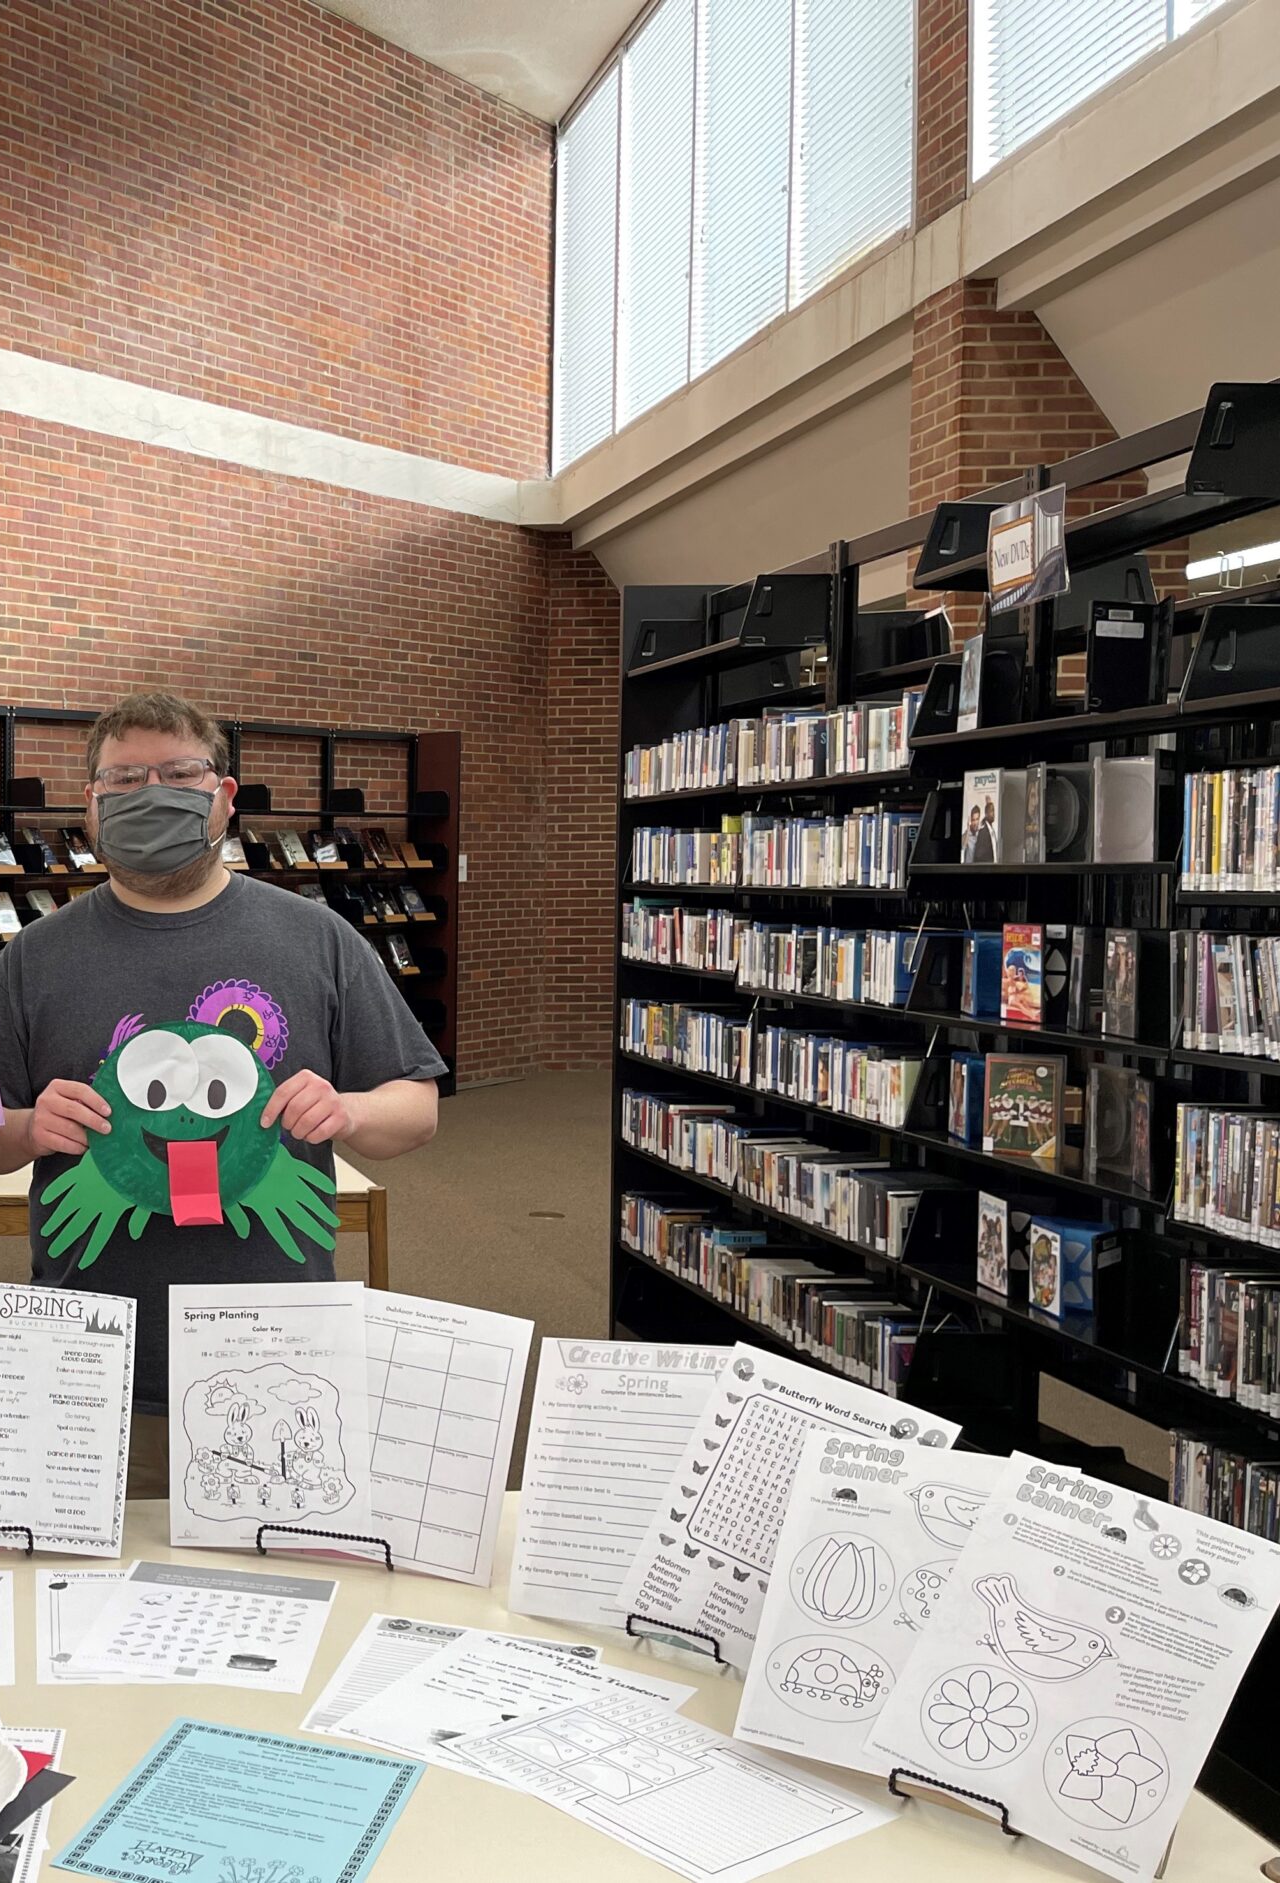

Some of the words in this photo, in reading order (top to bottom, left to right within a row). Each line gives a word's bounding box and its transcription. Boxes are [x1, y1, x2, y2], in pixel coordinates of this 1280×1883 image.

[994, 549, 1009, 570] New
[1010, 539, 1030, 564] DVDs
[0, 1293, 84, 1320] SPRING
[184, 1311, 216, 1321] Spring
[219, 1310, 259, 1321] Planting
[569, 1346, 649, 1366] Creative
[618, 1375, 669, 1393] Spring
[779, 1385, 823, 1409] Butterfly
[824, 1402, 851, 1418] Word
[852, 1411, 887, 1432] Search
[824, 1438, 905, 1466] Spring
[820, 1457, 908, 1485] Banner
[1026, 1465, 1114, 1509] Spring
[1016, 1483, 1112, 1528] Banner
[1195, 1528, 1209, 1537] This
[1211, 1533, 1236, 1548] project
[1237, 1544, 1256, 1556] works
[1195, 1545, 1216, 1560] heavy
[1196, 1537, 1208, 1546] best
[1209, 1540, 1235, 1555] printed
[1236, 1551, 1247, 1560] on
[651, 1563, 682, 1582] Antenna
[655, 1554, 691, 1575] Abdomen
[643, 1580, 682, 1604] Caterpillar
[647, 1571, 680, 1592] Butterfly
[635, 1598, 650, 1612] Egg
[639, 1590, 673, 1611] Chrysalis
[709, 1591, 745, 1614] Hindwing
[713, 1582, 749, 1605] Forewing
[705, 1600, 727, 1615] Larva
[697, 1618, 726, 1638] Migrate
[701, 1609, 757, 1641] Metamorphosi
